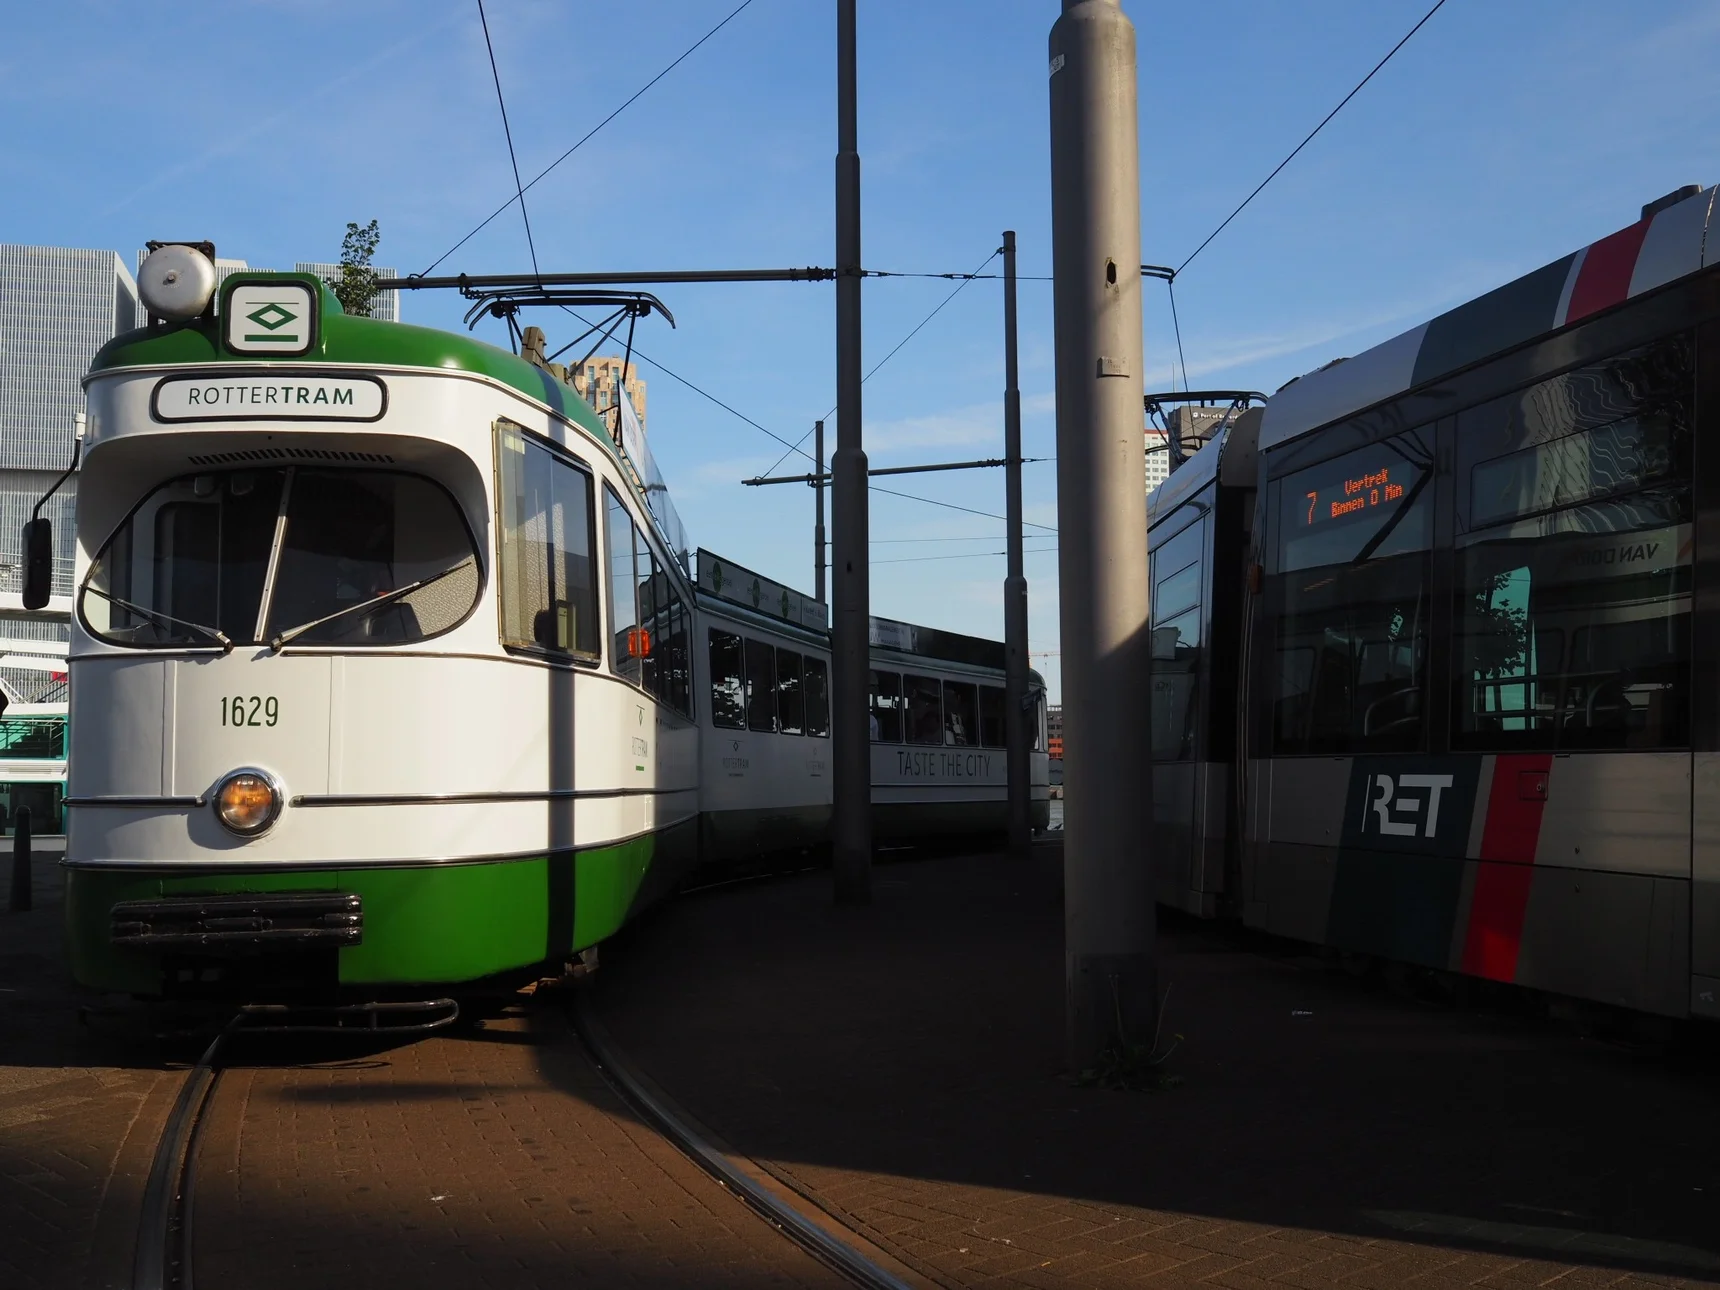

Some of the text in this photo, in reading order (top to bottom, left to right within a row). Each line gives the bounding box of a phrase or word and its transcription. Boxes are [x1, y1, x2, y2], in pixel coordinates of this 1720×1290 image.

[188, 386, 354, 405] ROTTERTRAM
[1344, 468, 1389, 496] Vertrek
[1306, 491, 1318, 525] 7
[1331, 497, 1366, 518] Binnen
[1384, 484, 1404, 502] Min
[221, 696, 279, 727] 1629
[897, 751, 990, 777] TASTE THE CITY
[1361, 774, 1454, 838] RET
